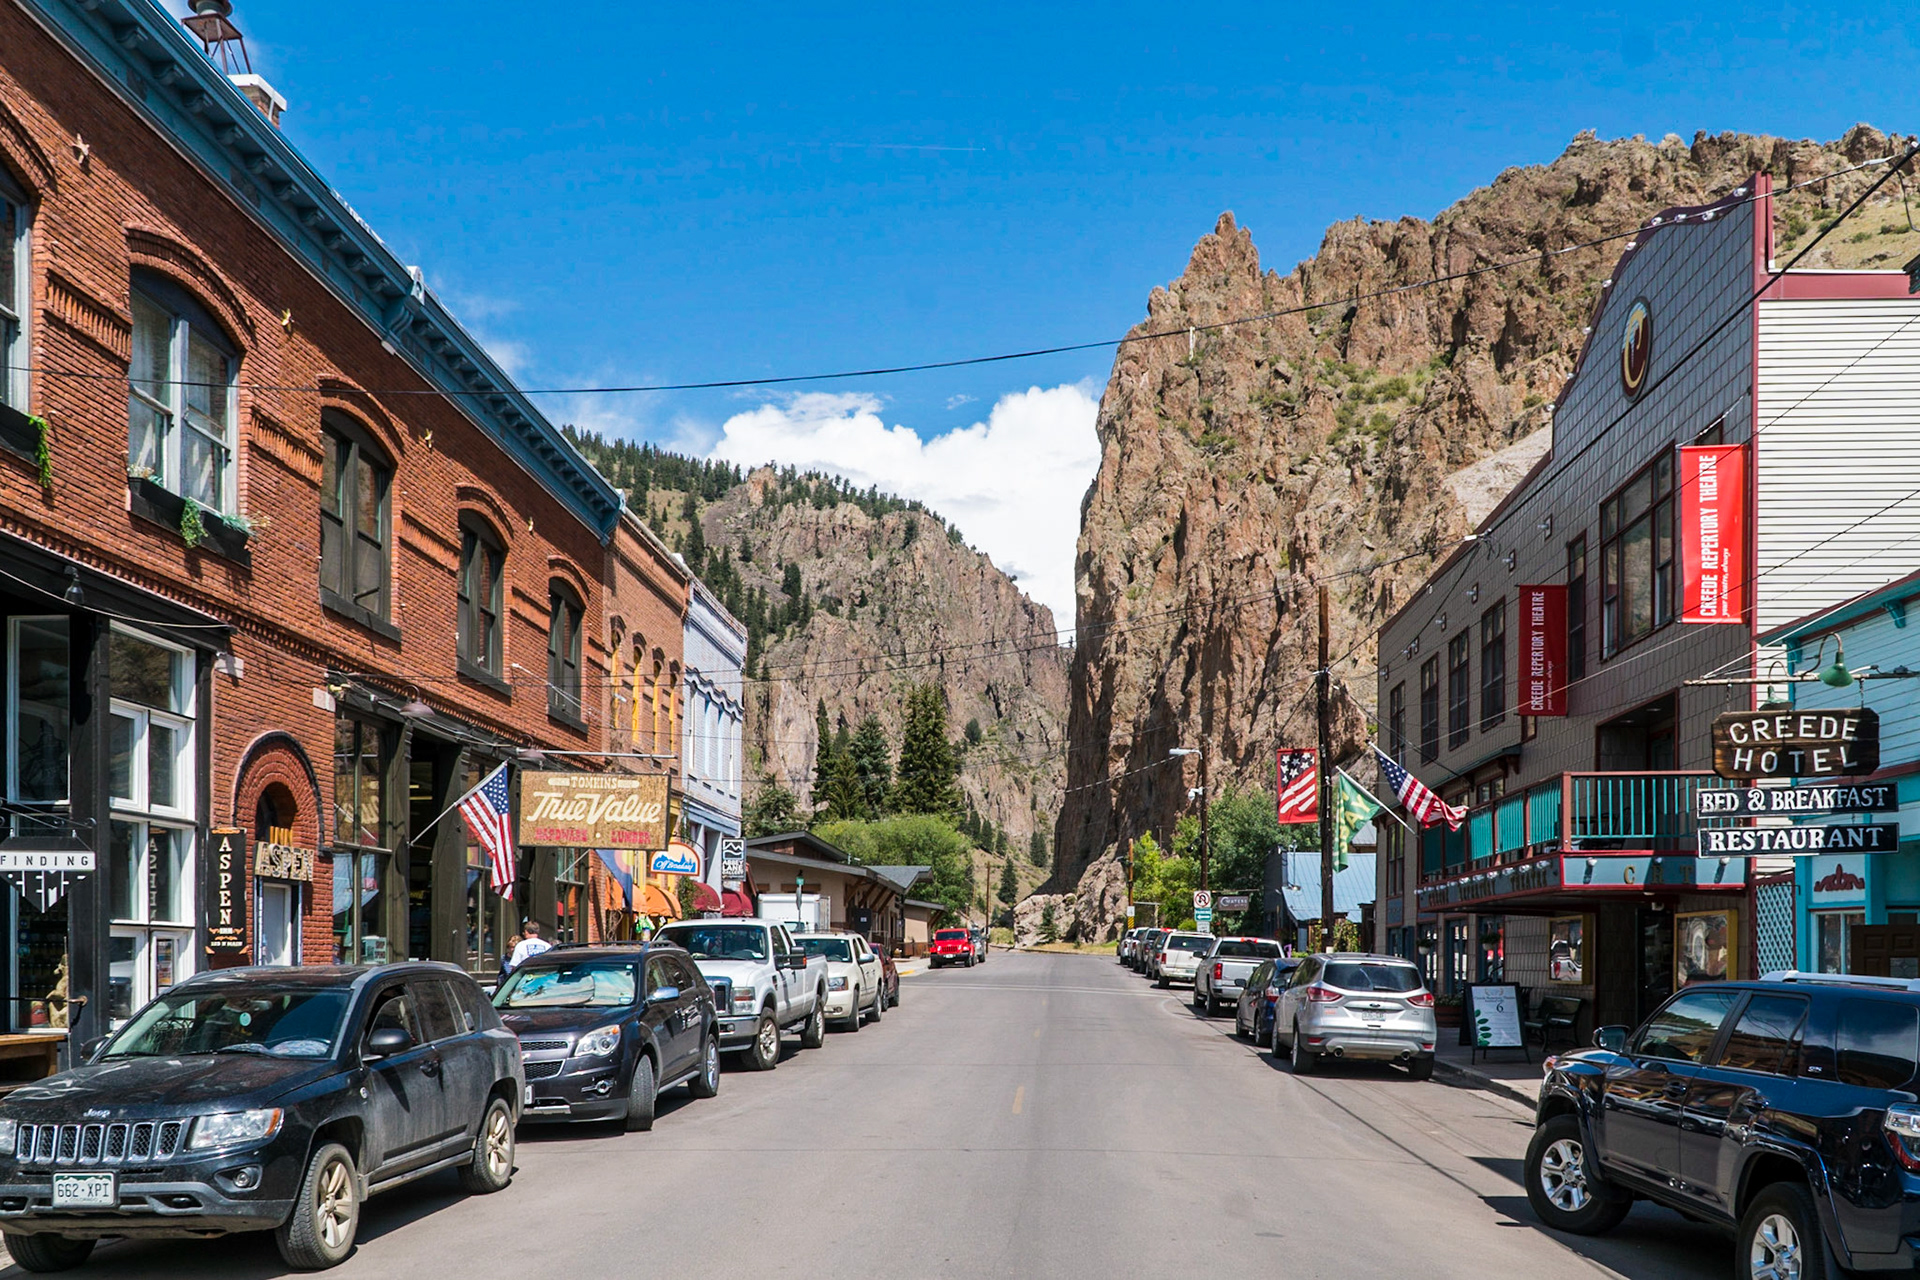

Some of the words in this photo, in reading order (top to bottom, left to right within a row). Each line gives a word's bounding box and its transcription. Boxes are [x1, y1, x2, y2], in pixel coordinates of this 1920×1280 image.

[1699, 454, 1718, 503] THEATRE
[1699, 507, 1719, 570] REPERTORY
[1531, 591, 1545, 626] THEATRE
[1699, 574, 1718, 617] CREEDE
[1531, 631, 1545, 677] REPERTORY
[1530, 680, 1544, 711] CREEDE
[1728, 715, 1860, 744] CREEDE
[1733, 746, 1858, 774] HOTEL
[570, 776, 618, 789] TOMKINS
[1701, 791, 1739, 812] BED
[1747, 788, 1767, 811] &
[1771, 787, 1888, 811] BREAKFAST
[1709, 827, 1884, 852] RESTAURANT
[0, 855, 89, 866] FINDING
[258, 842, 315, 882] ASPEN
[219, 836, 233, 925] ASPEN
[83, 1108, 111, 1118] Jeep
